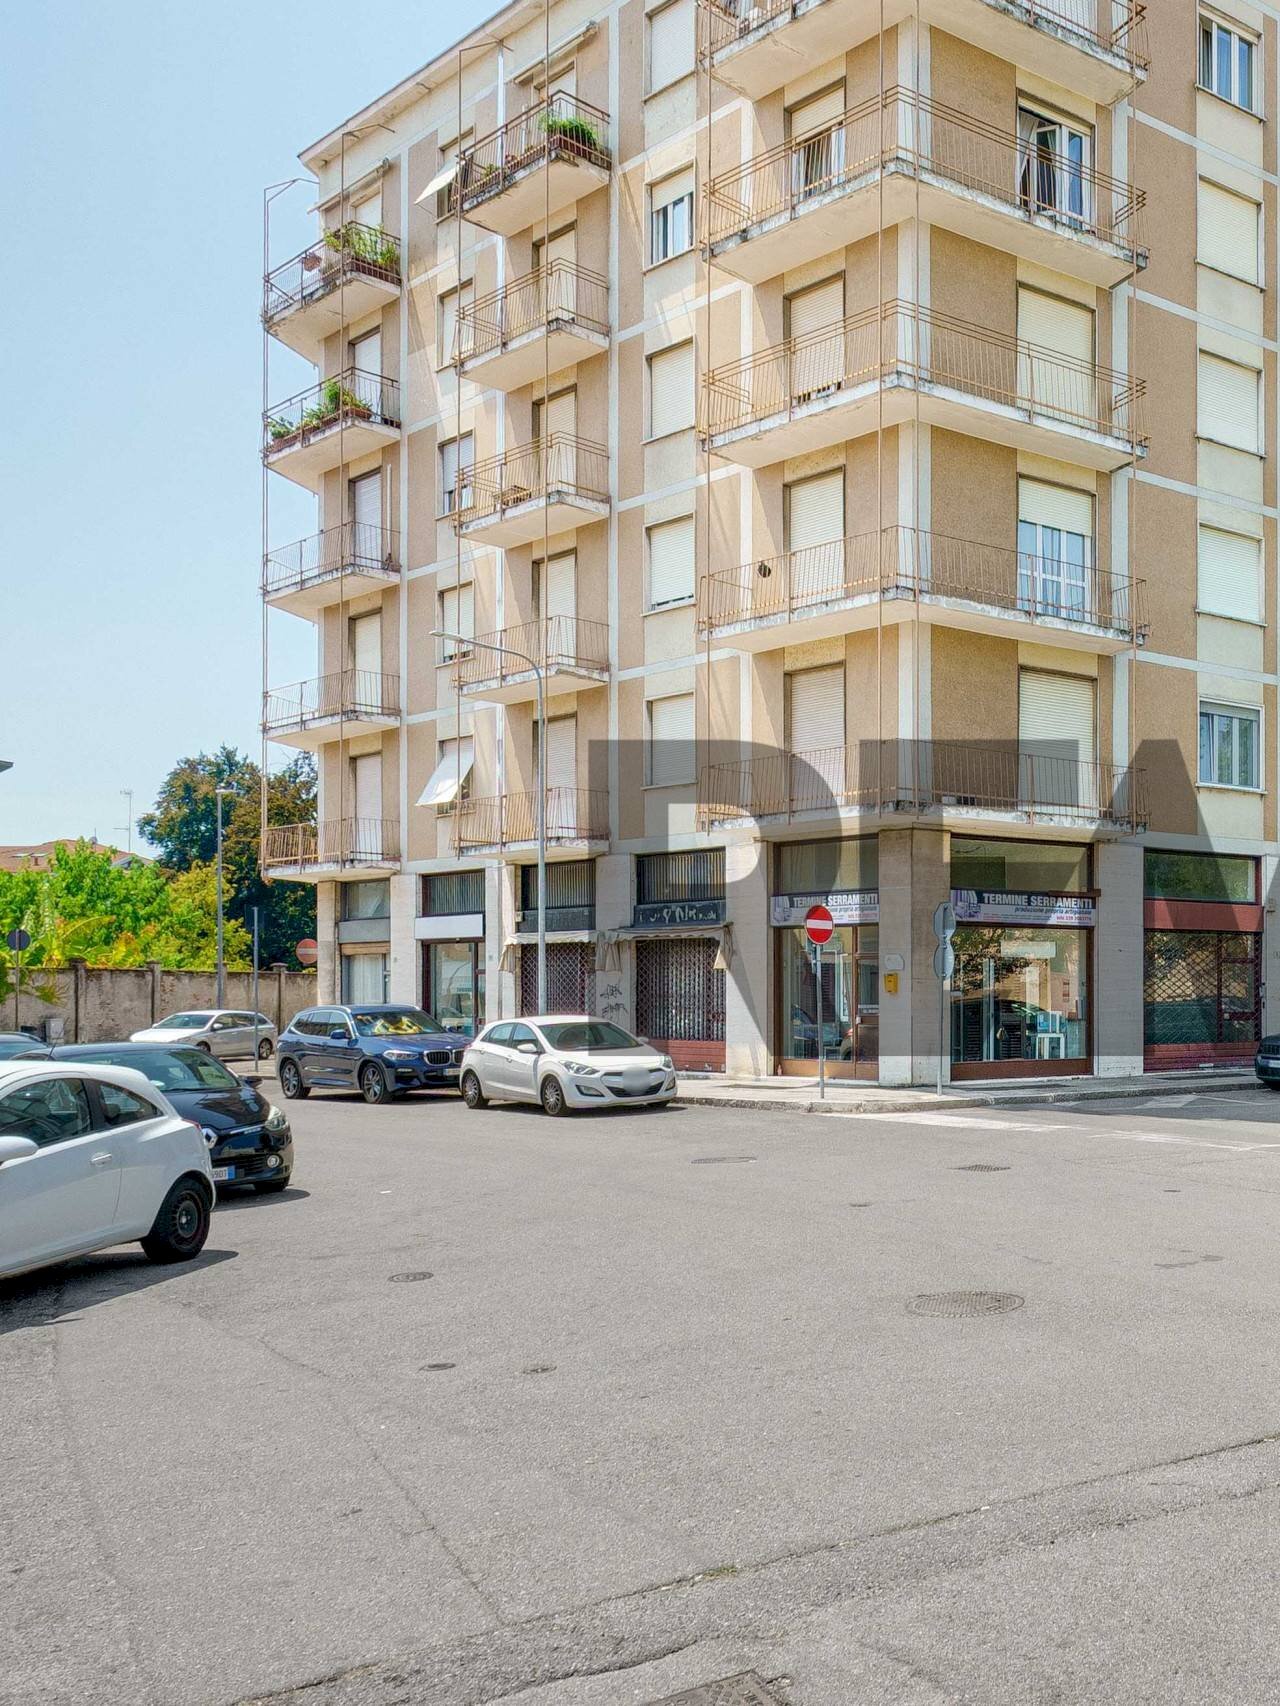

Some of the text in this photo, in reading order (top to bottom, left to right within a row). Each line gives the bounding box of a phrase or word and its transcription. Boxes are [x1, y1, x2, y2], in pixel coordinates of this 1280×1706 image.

[793, 894, 878, 908] TERMINE SERRAMENTI
[983, 894, 1092, 908] TERMINE SERRAMENTI
